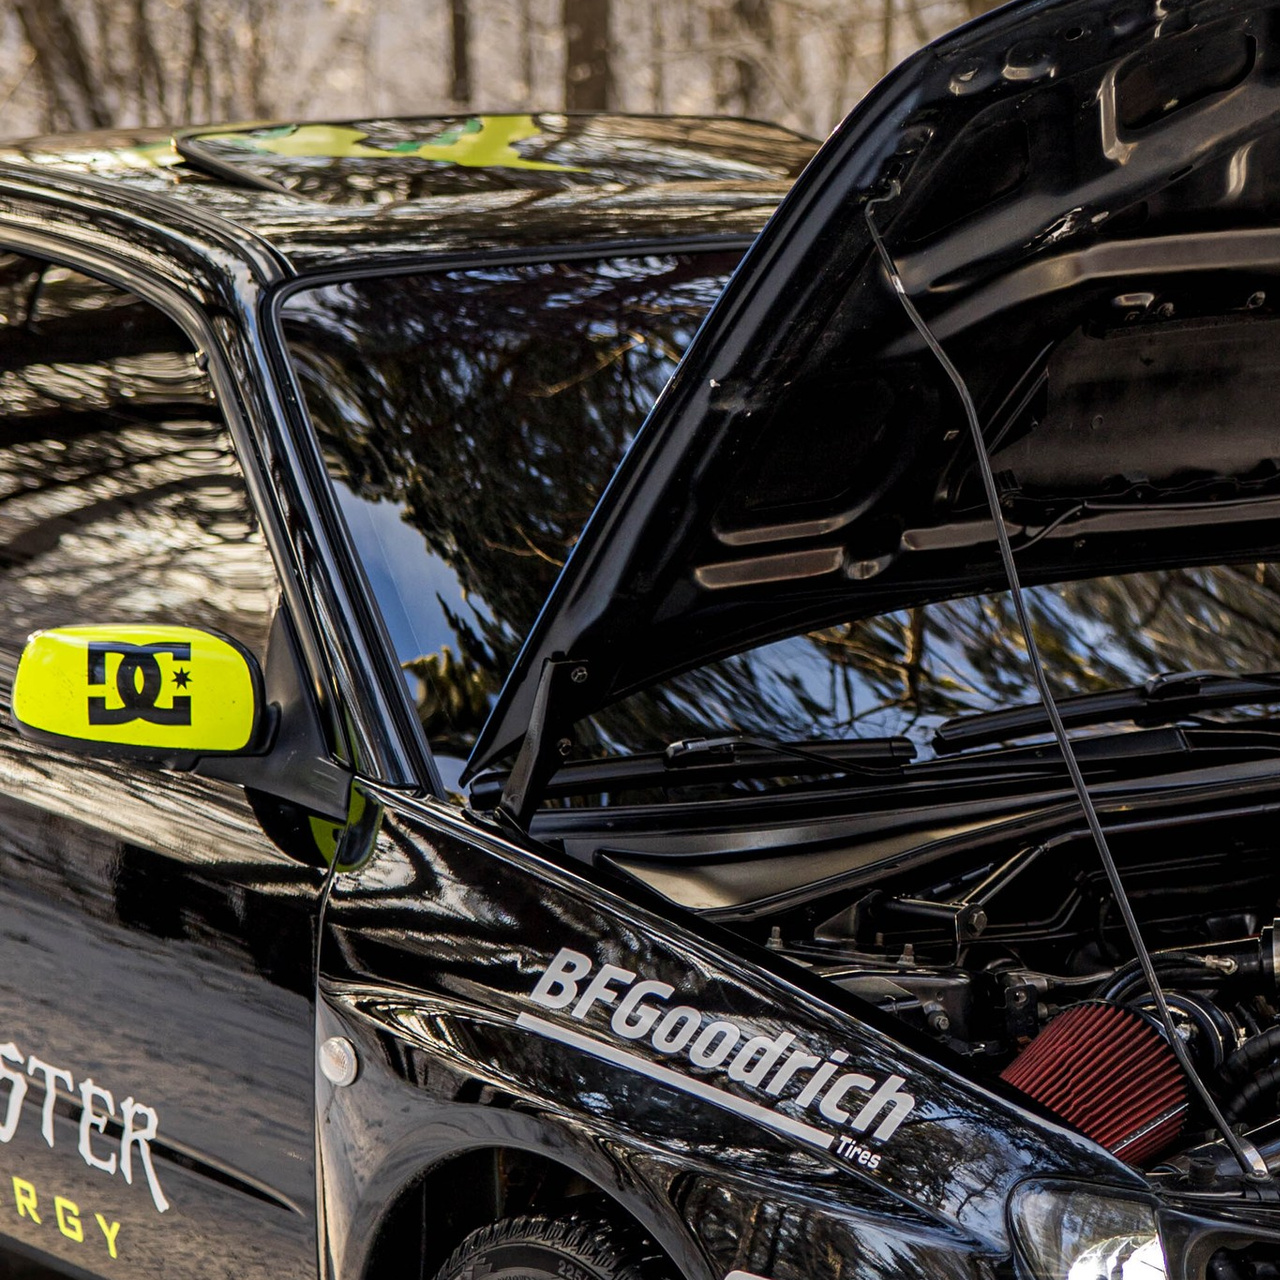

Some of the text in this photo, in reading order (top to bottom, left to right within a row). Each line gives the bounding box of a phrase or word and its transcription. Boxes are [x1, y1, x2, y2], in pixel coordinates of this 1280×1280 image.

[88, 641, 191, 726] DC
[530, 947, 916, 1142] BFGoodrich
[835, 1135, 881, 1170] Tires
[12, 1176, 120, 1259] RGY
